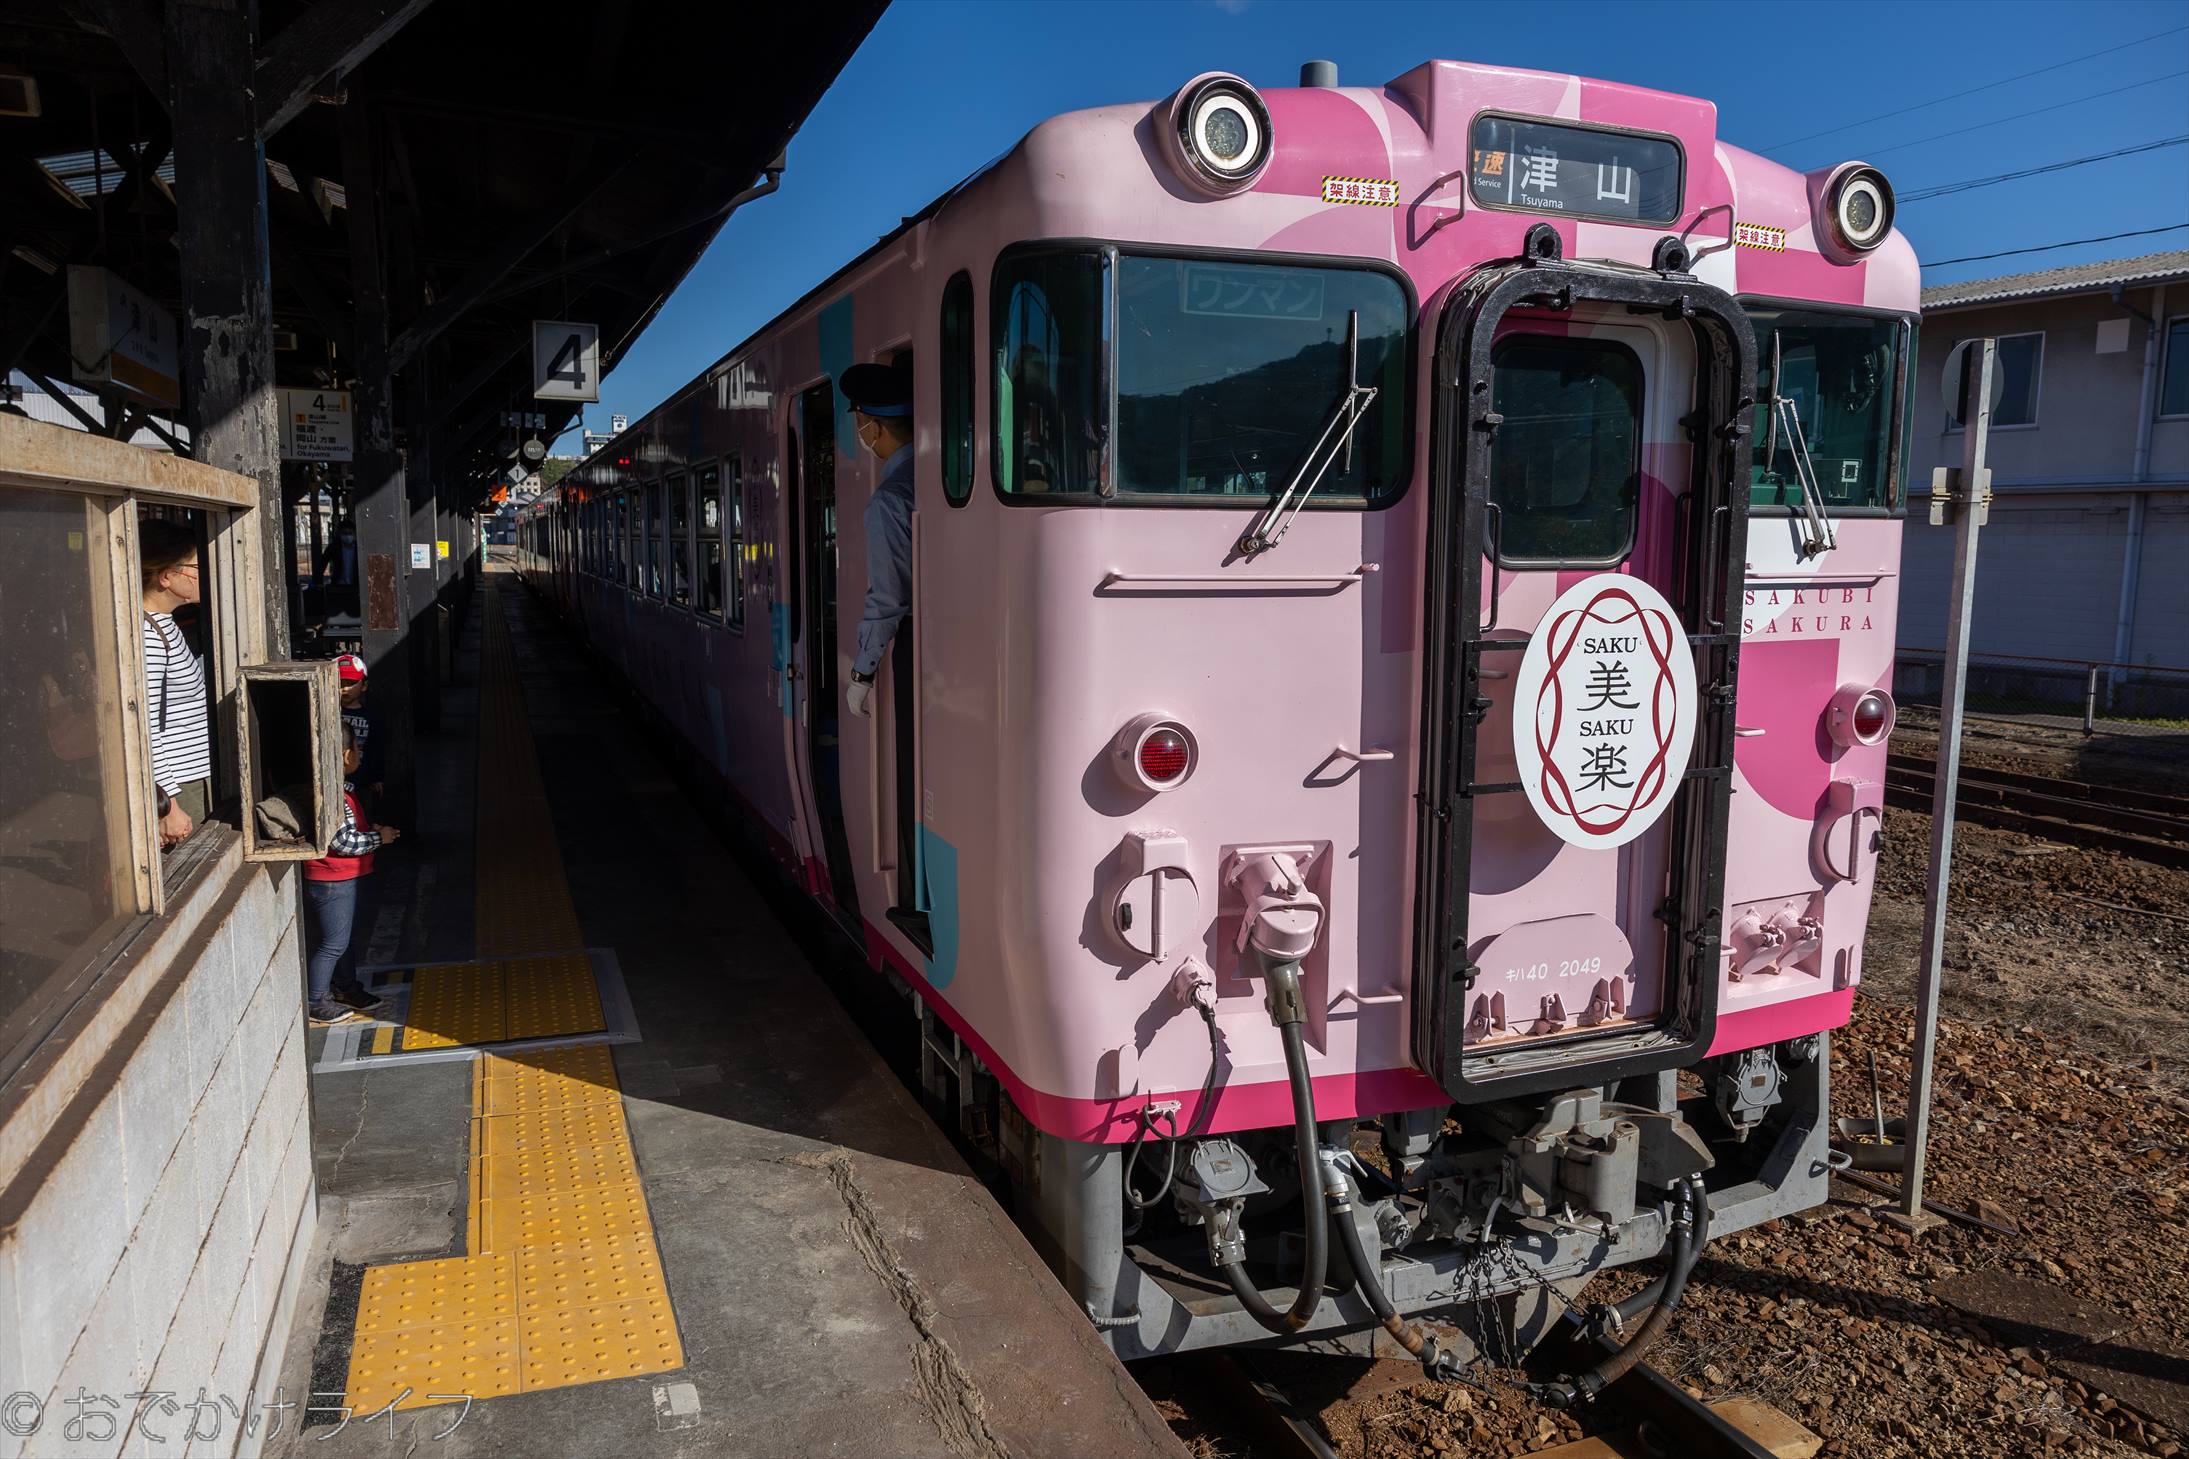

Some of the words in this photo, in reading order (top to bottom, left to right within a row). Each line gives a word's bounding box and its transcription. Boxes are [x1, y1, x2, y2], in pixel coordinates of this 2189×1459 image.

[1478, 178, 1501, 188] Service
[1520, 145, 1631, 204] 津山
[1329, 182, 1391, 201] 架線注意
[1521, 194, 1563, 209] Tsuyama
[1739, 229, 1780, 246] 架線注意
[1193, 274, 1317, 312] ワンマン
[546, 334, 586, 390] 4
[313, 394, 325, 411] 4
[1745, 587, 1872, 605] SAKUBI
[1743, 615, 1872, 634] SAKURA
[1583, 637, 1638, 654] SAKU
[1577, 660, 1641, 711] 美
[1579, 719, 1634, 736] SAKU
[1575, 742, 1635, 792] 楽
[1559, 957, 1601, 977] 2049
